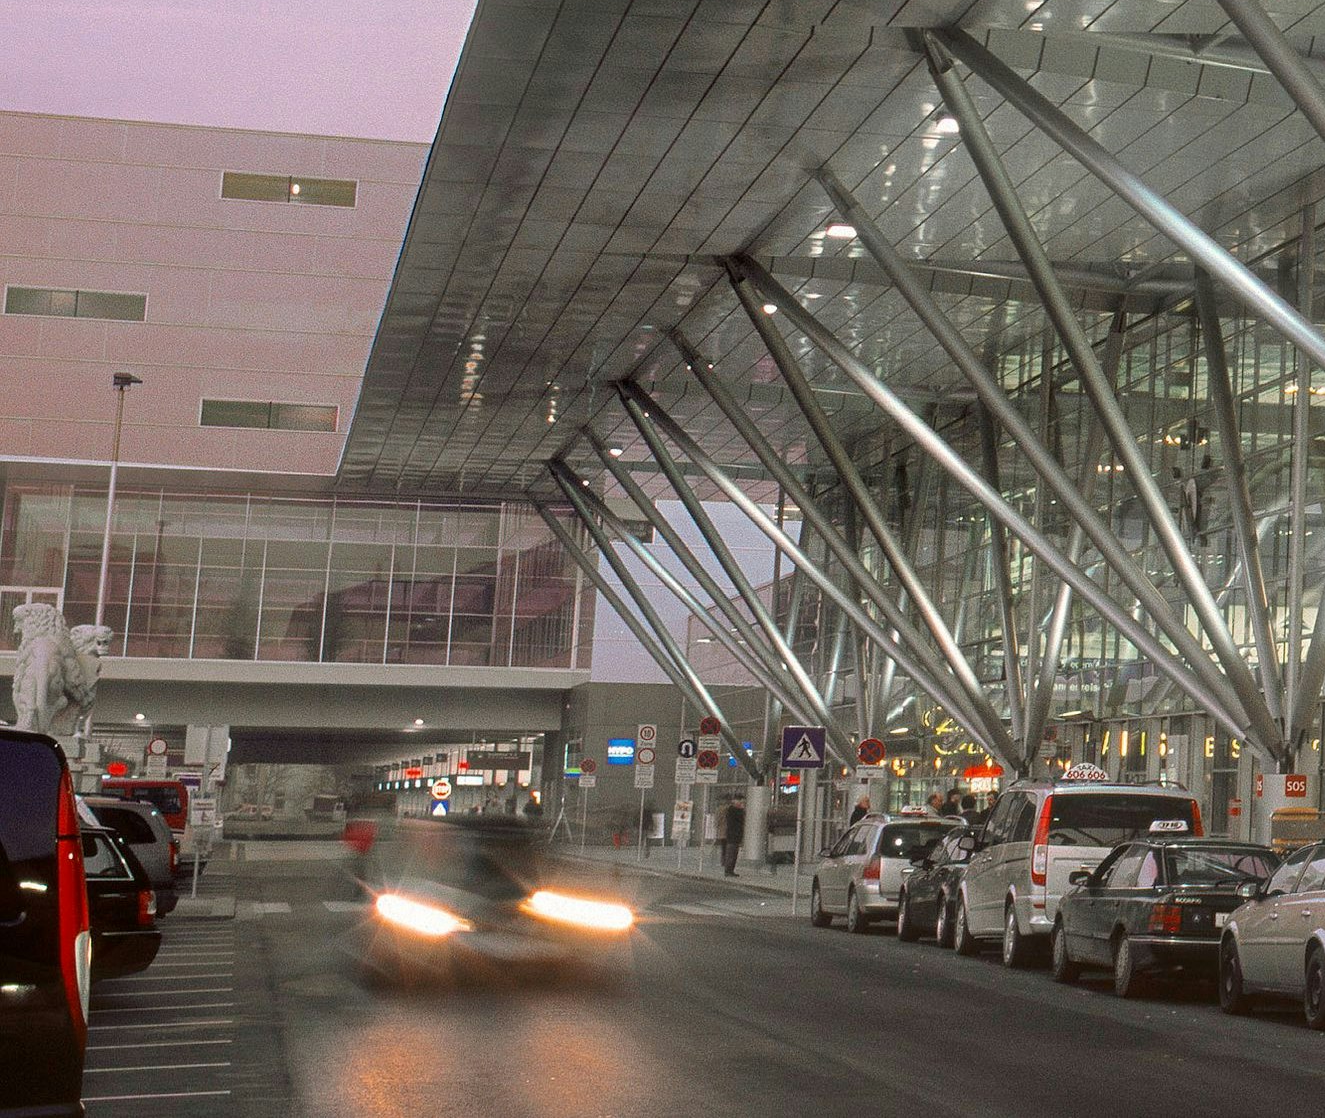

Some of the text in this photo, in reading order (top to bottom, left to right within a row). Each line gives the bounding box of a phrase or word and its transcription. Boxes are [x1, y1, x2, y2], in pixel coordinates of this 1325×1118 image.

[1067, 771, 1106, 779] 606 606
[1286, 782, 1306, 791] SOS
